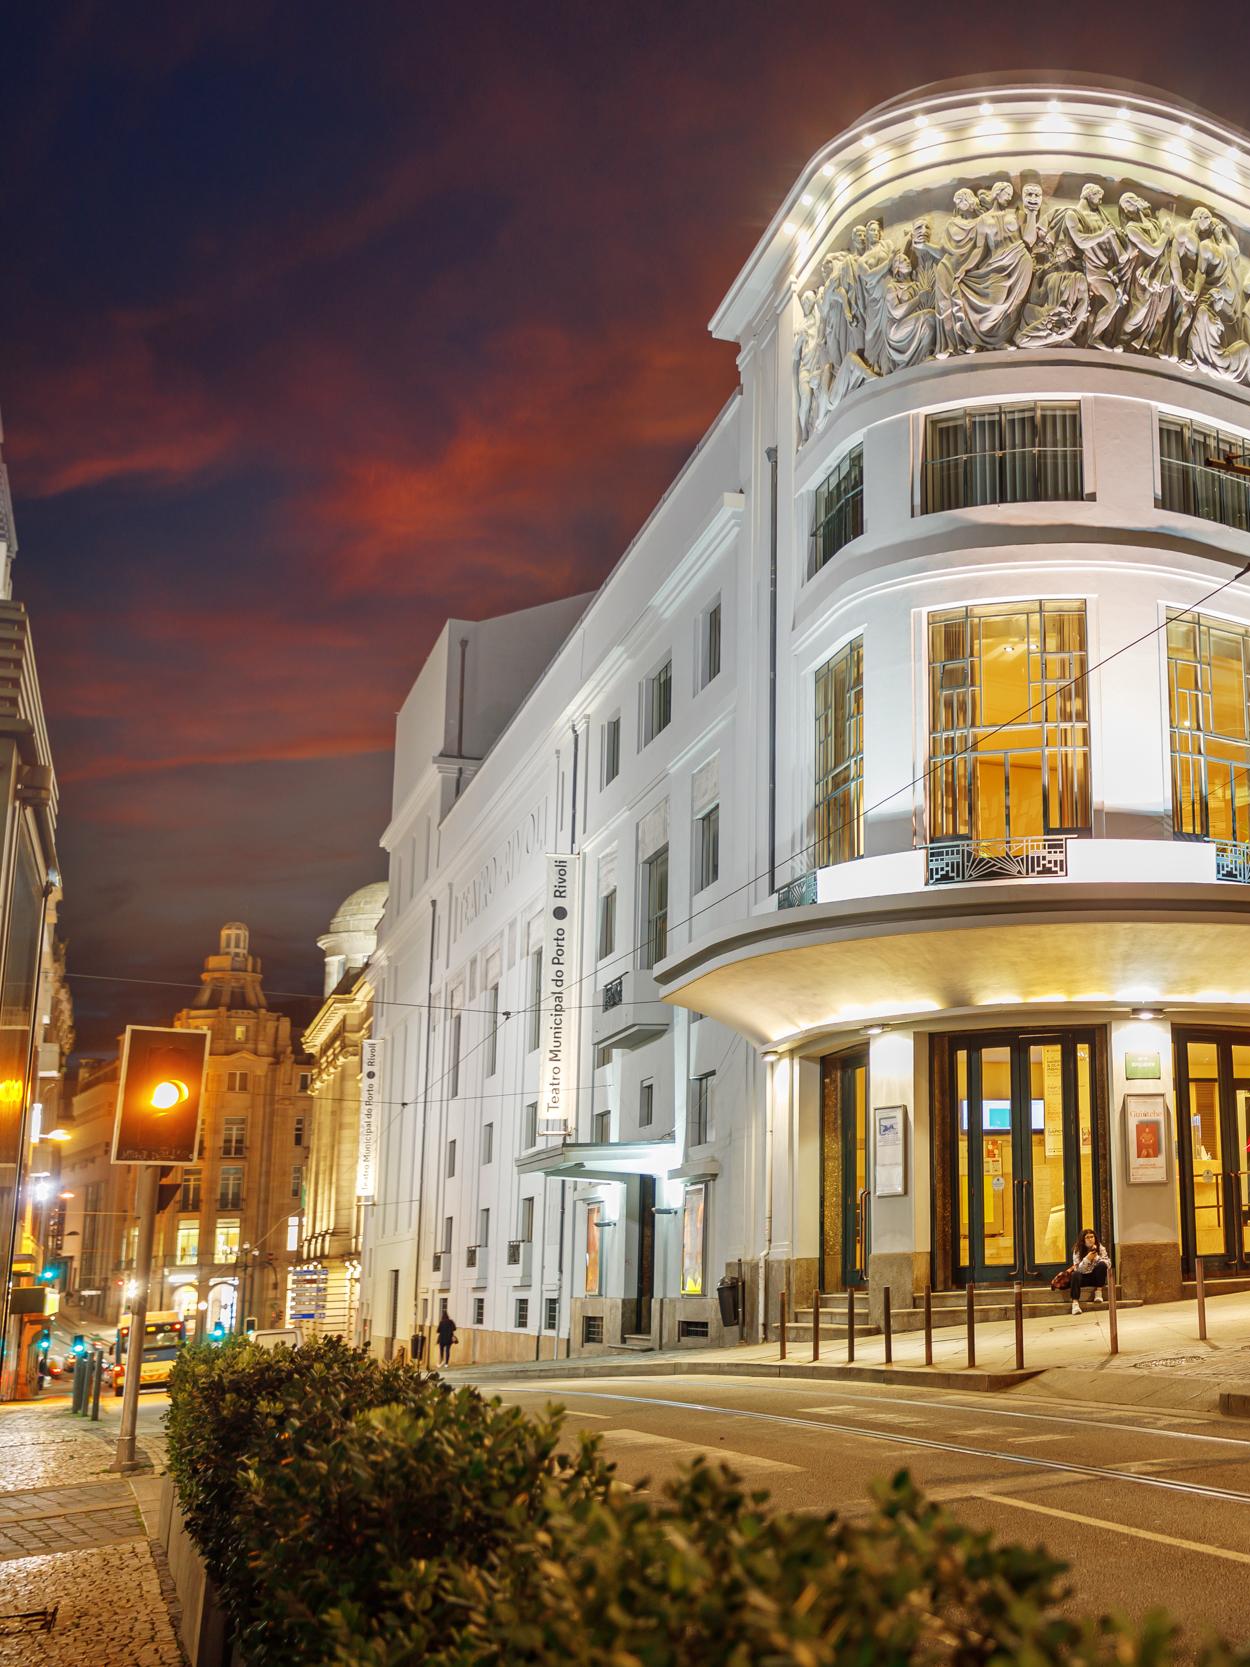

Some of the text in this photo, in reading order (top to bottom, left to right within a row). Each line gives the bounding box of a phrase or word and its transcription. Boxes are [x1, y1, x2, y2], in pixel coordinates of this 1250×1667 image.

[547, 860, 568, 1112] Teatro Municipal do Porto Rivoli
[367, 1043, 377, 1067] Rivoli
[365, 1083, 374, 1106] Porto
[365, 1106, 373, 1119] do
[363, 1119, 373, 1160] Municipal
